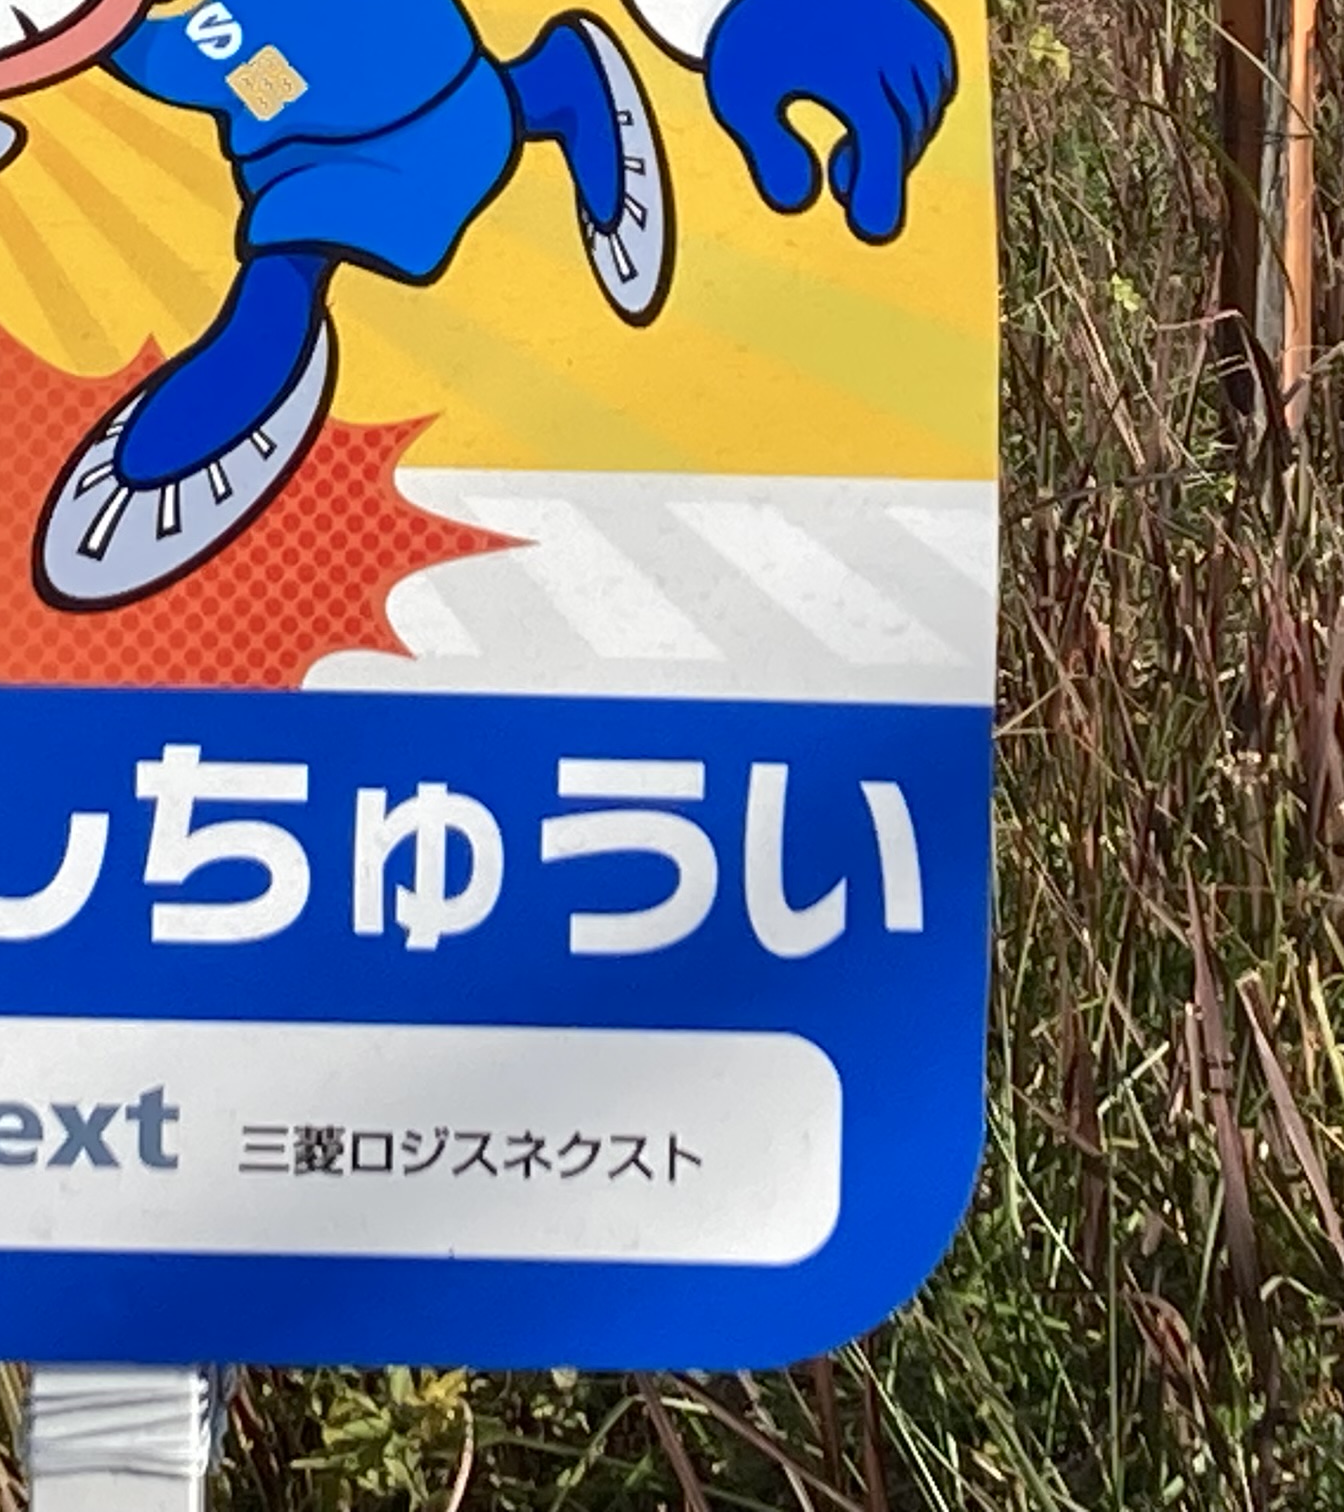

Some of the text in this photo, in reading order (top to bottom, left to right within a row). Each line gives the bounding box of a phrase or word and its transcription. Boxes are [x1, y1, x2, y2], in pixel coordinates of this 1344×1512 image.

[238, 1124, 703, 1183] 三菱ロジスネクスト
